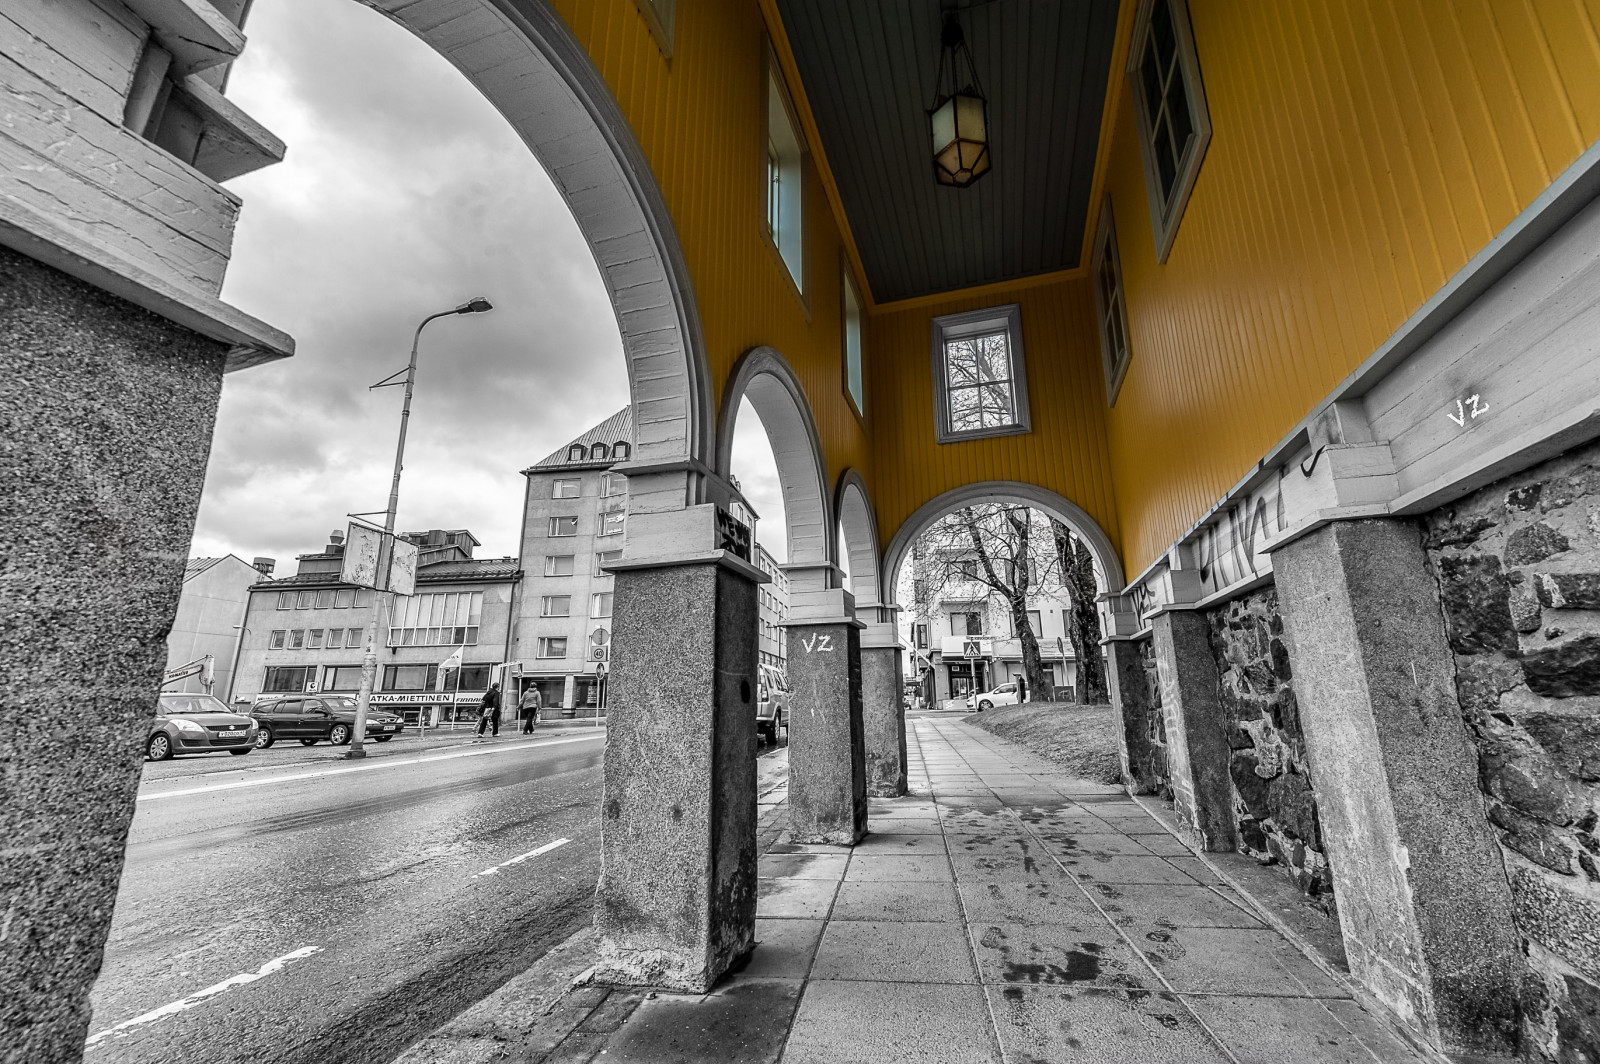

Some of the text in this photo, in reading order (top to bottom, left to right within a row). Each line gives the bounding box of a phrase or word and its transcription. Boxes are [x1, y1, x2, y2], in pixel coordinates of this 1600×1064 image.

[1446, 393, 1490, 428] VZ
[801, 632, 834, 654] VZ
[362, 694, 450, 702] ATKA-MIETTINEN
